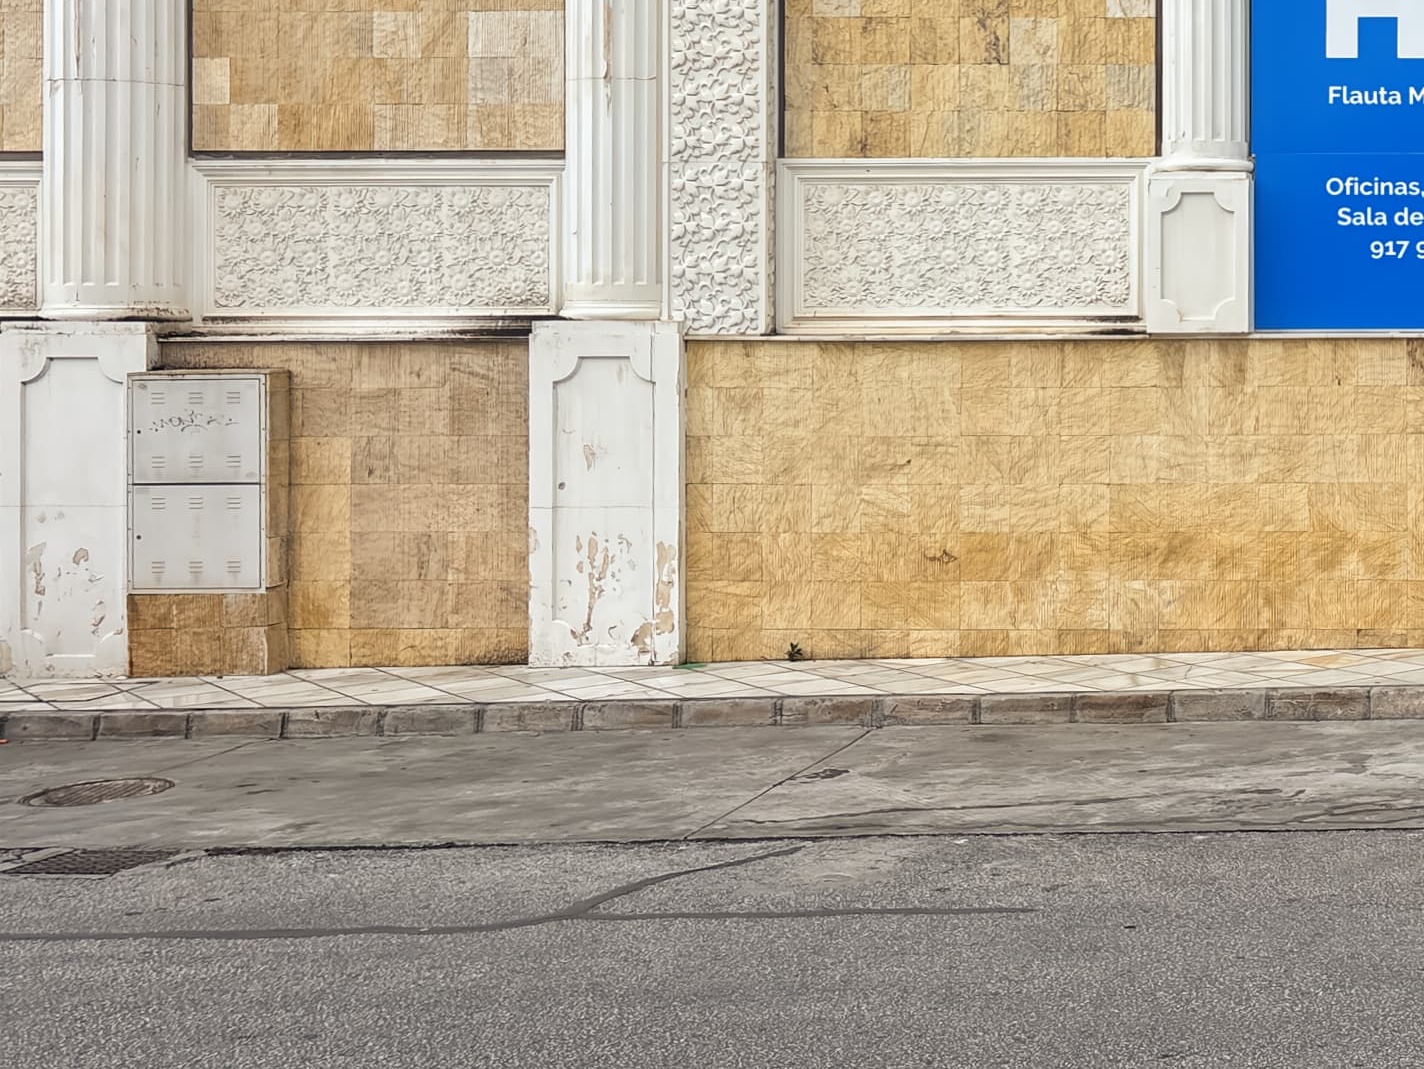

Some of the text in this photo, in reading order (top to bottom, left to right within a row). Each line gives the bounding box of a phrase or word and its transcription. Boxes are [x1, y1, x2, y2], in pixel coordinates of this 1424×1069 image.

[1328, 85, 1402, 106] Flauta
[1336, 206, 1388, 227] Sala
[1394, 206, 1424, 227] de
[1369, 240, 1410, 260] 917
